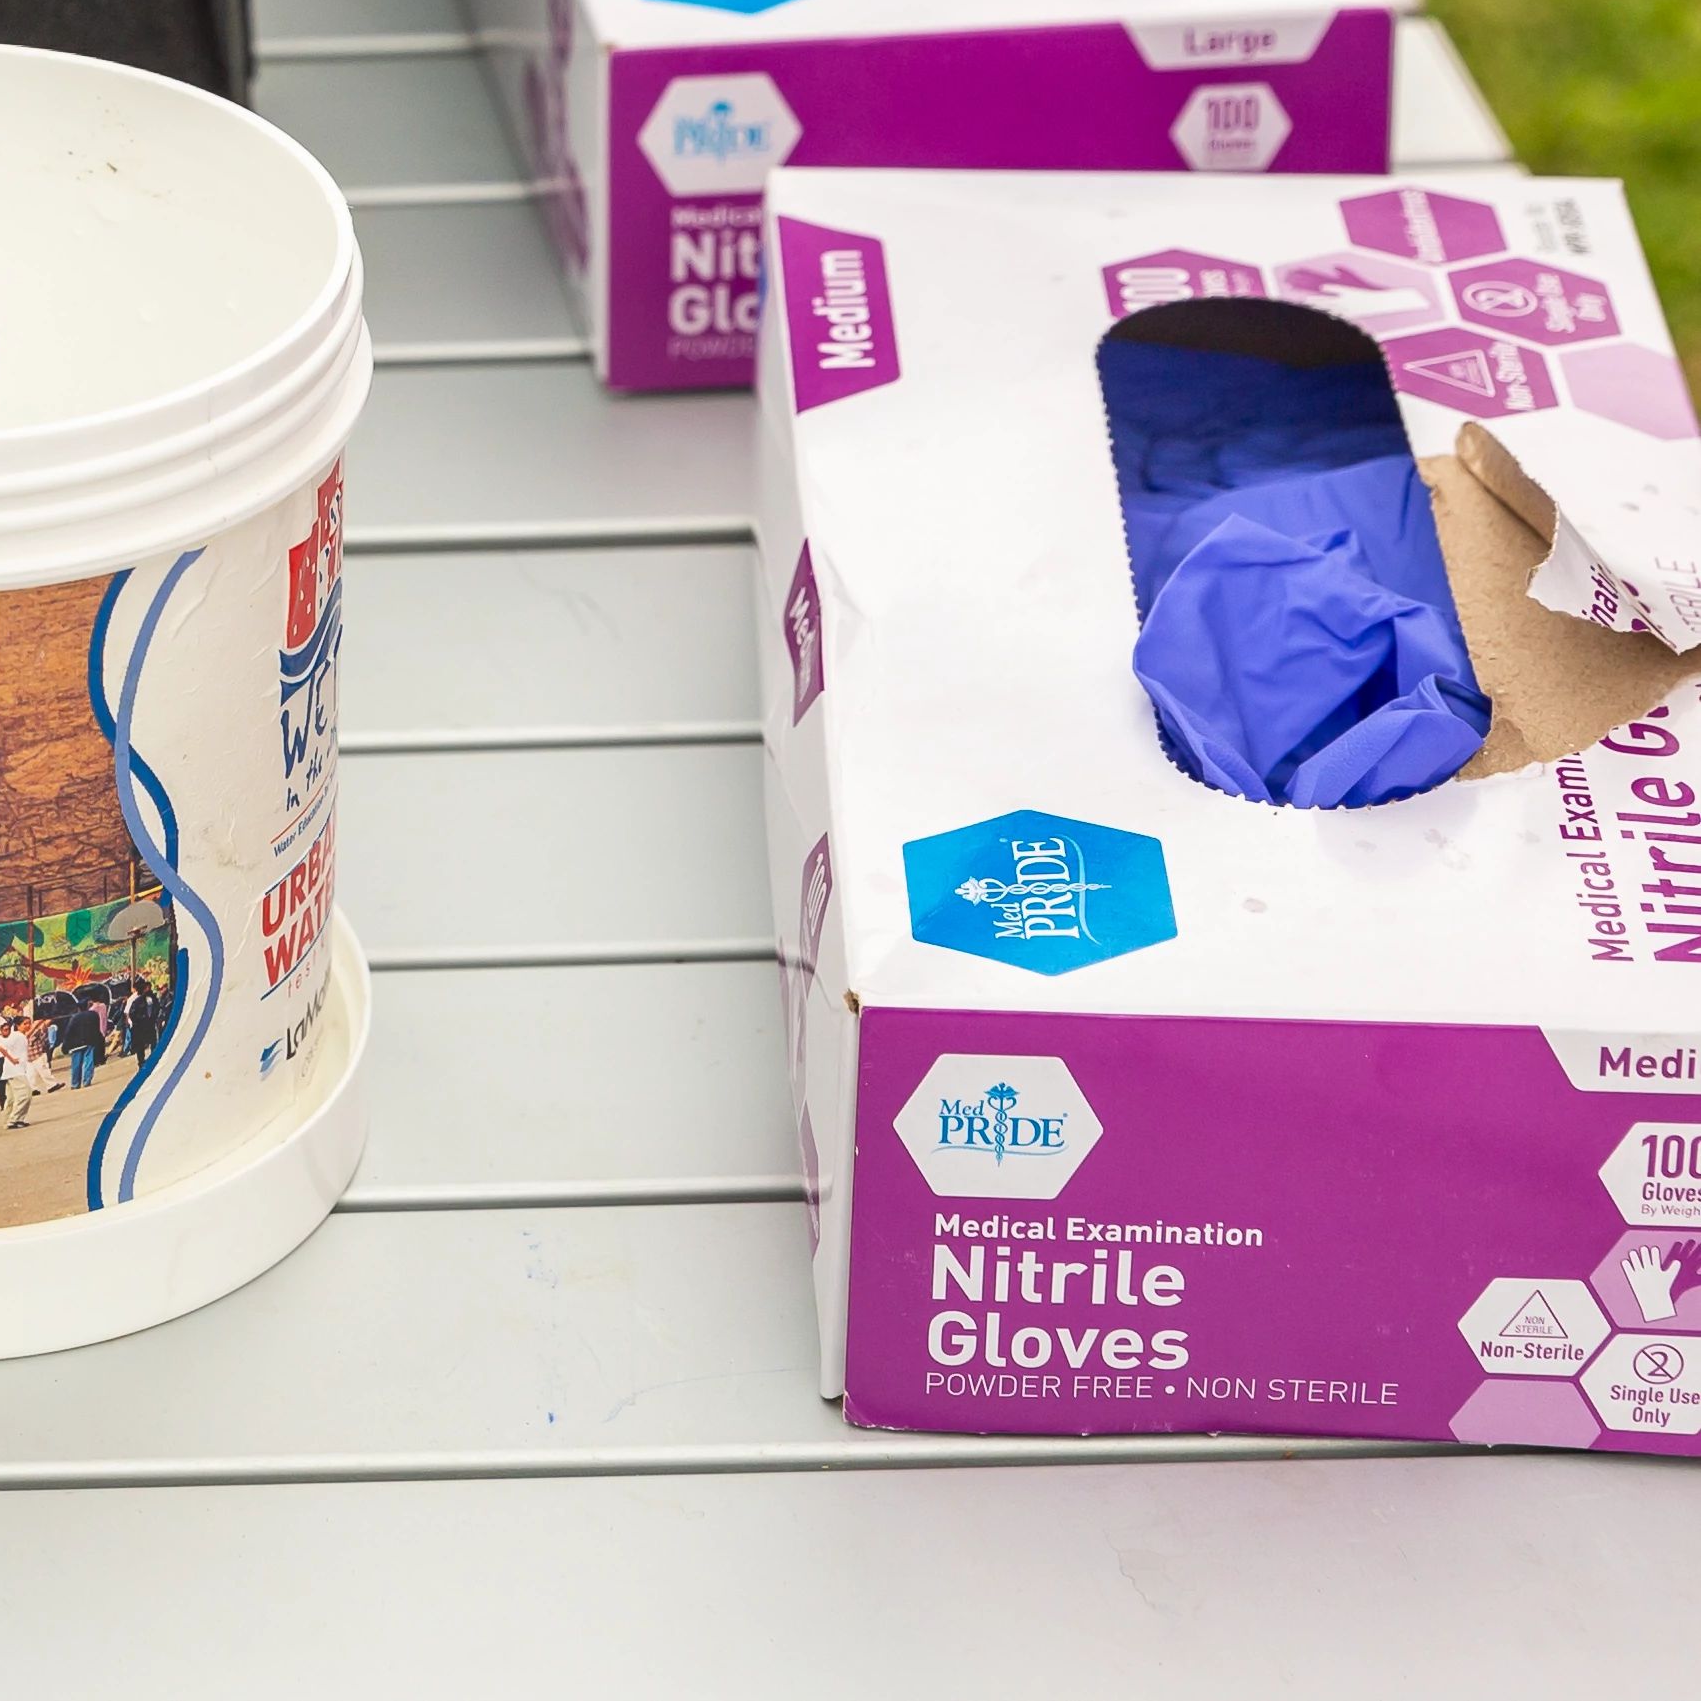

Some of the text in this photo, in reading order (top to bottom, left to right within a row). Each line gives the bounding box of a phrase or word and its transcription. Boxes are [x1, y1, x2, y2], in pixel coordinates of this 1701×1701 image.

[1184, 26, 1277, 59] Large
[1206, 97, 1260, 132] 100
[812, 250, 874, 371] Medium
[274, 830, 296, 857] Water
[991, 902, 1026, 940] Med
[1566, 851, 1634, 963] Medical
[1599, 1046, 1697, 1080] Medi
[940, 1099, 984, 1117] Med
[1641, 1204, 1657, 1219] By
[935, 1213, 1263, 1246] Medical Examination
[931, 1244, 1186, 1307] Nitrile
[1515, 1325, 1554, 1335] STERILE
[1524, 1315, 1545, 1325] NON
[926, 1310, 1190, 1370] Gloves
[1480, 1341, 1585, 1362] Non-Sterile
[925, 1372, 1399, 1405] POWDER FREE NON STERILE
[1610, 1385, 1700, 1405] Single Use
[1632, 1406, 1671, 1428] Only
